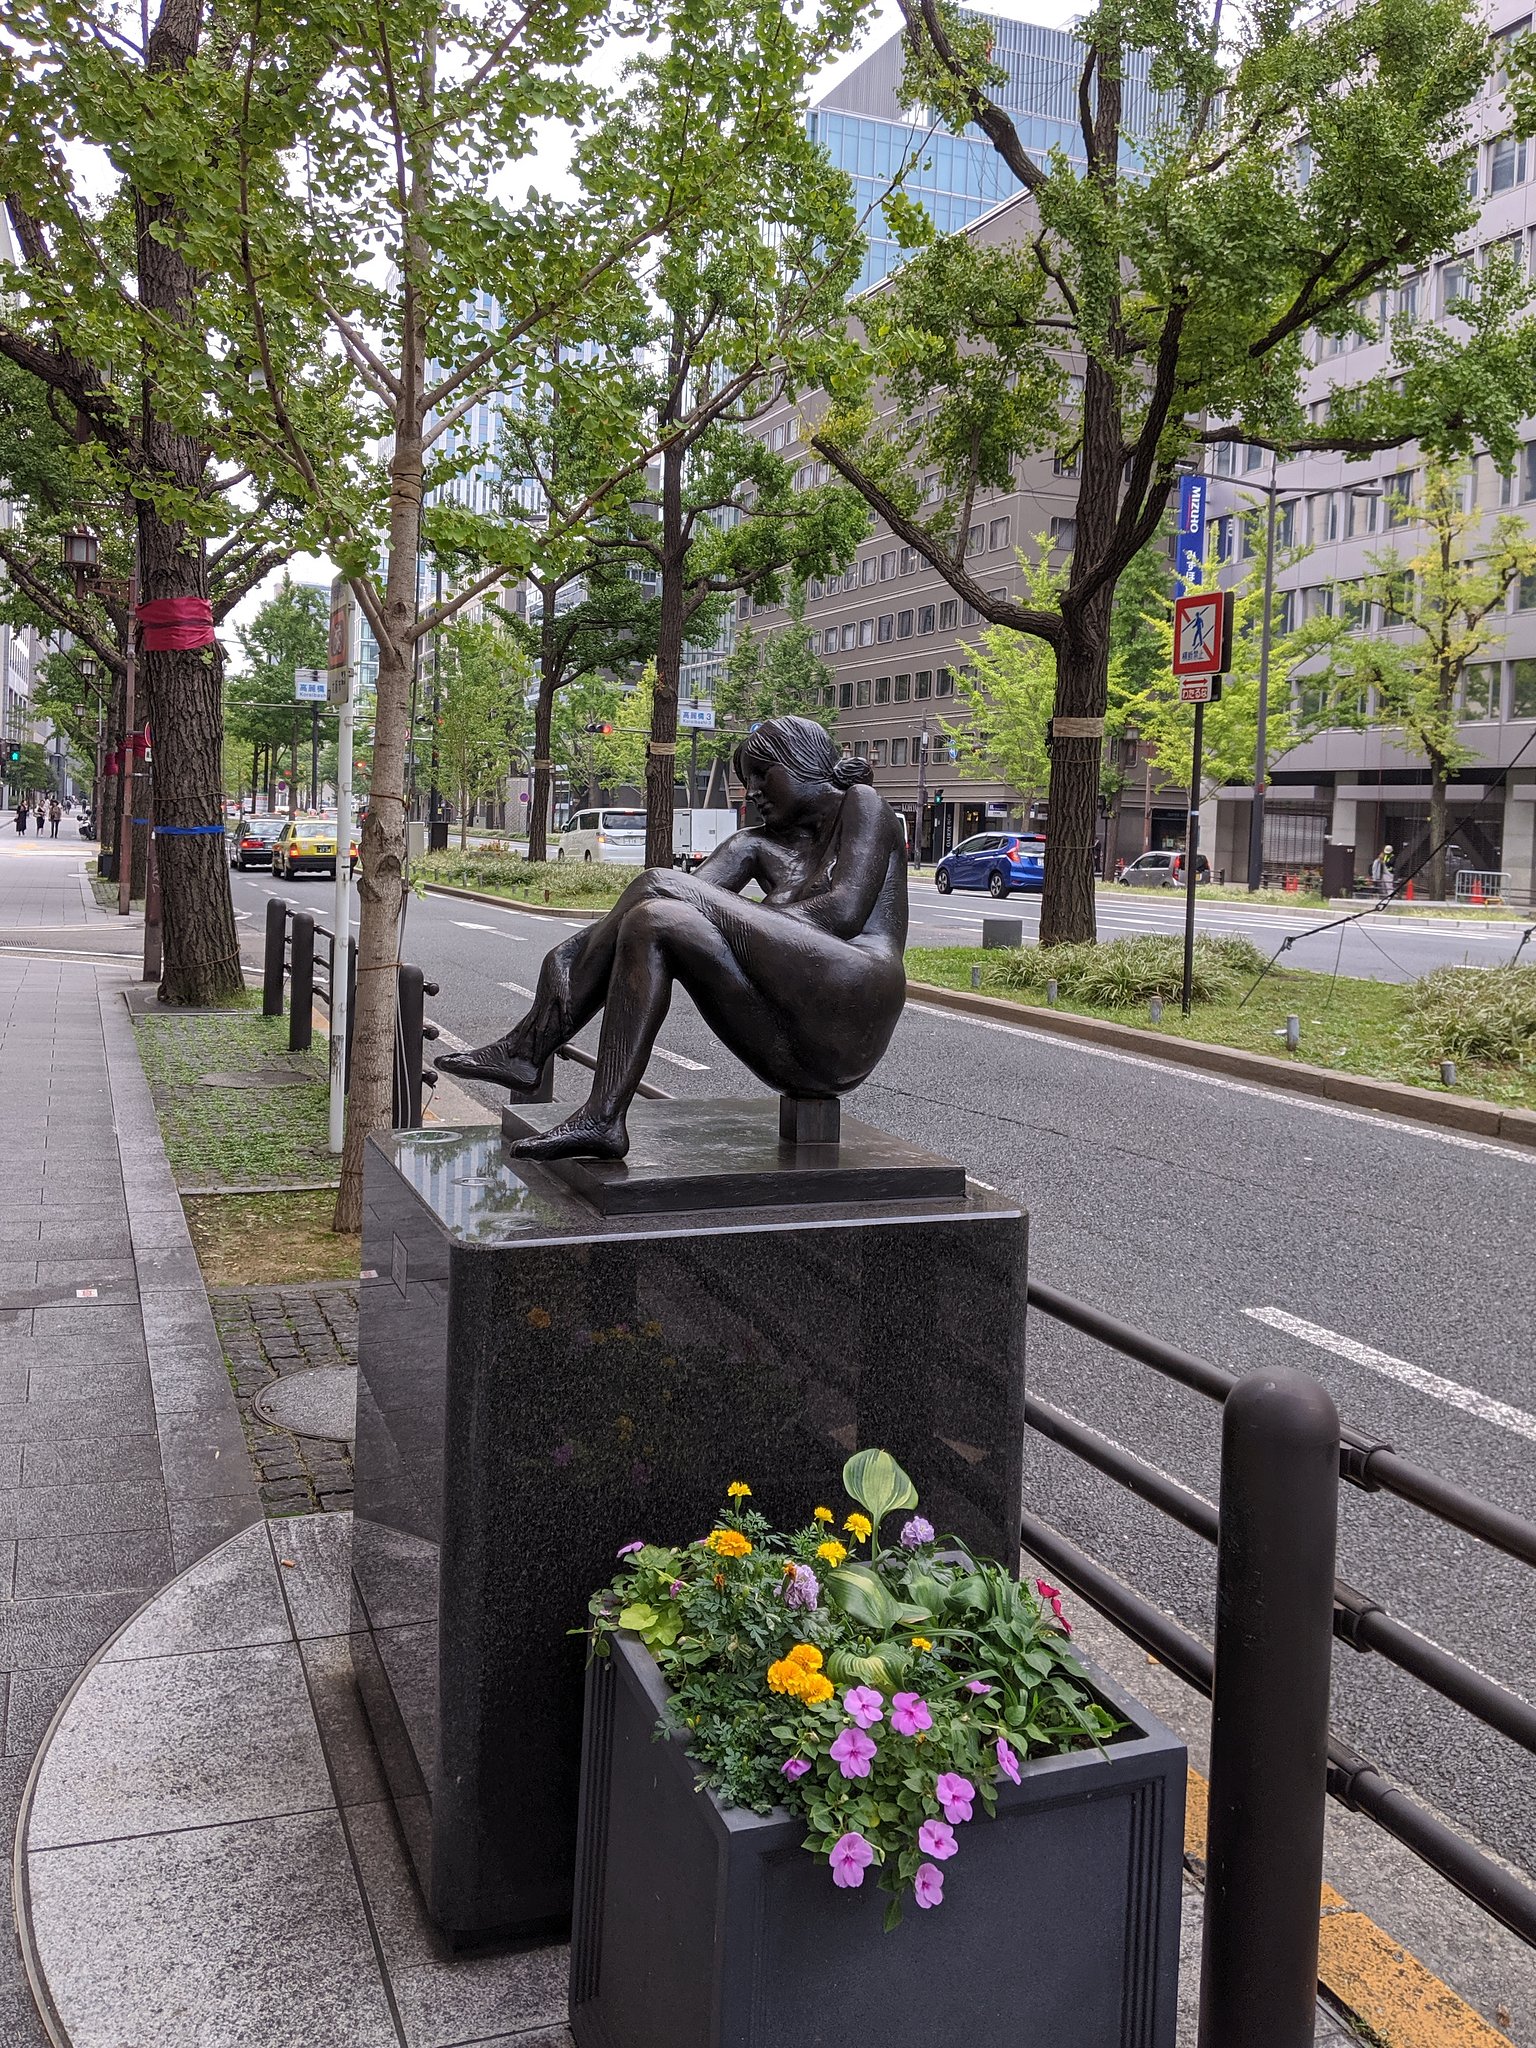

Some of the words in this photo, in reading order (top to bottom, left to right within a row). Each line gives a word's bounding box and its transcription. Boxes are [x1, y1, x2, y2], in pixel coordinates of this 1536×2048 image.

[1190, 486, 1201, 534] MIZUHO
[300, 684, 324, 692] 高麗橋
[1182, 688, 1207, 699] わたるな
[683, 712, 704, 720] 高麗橋
